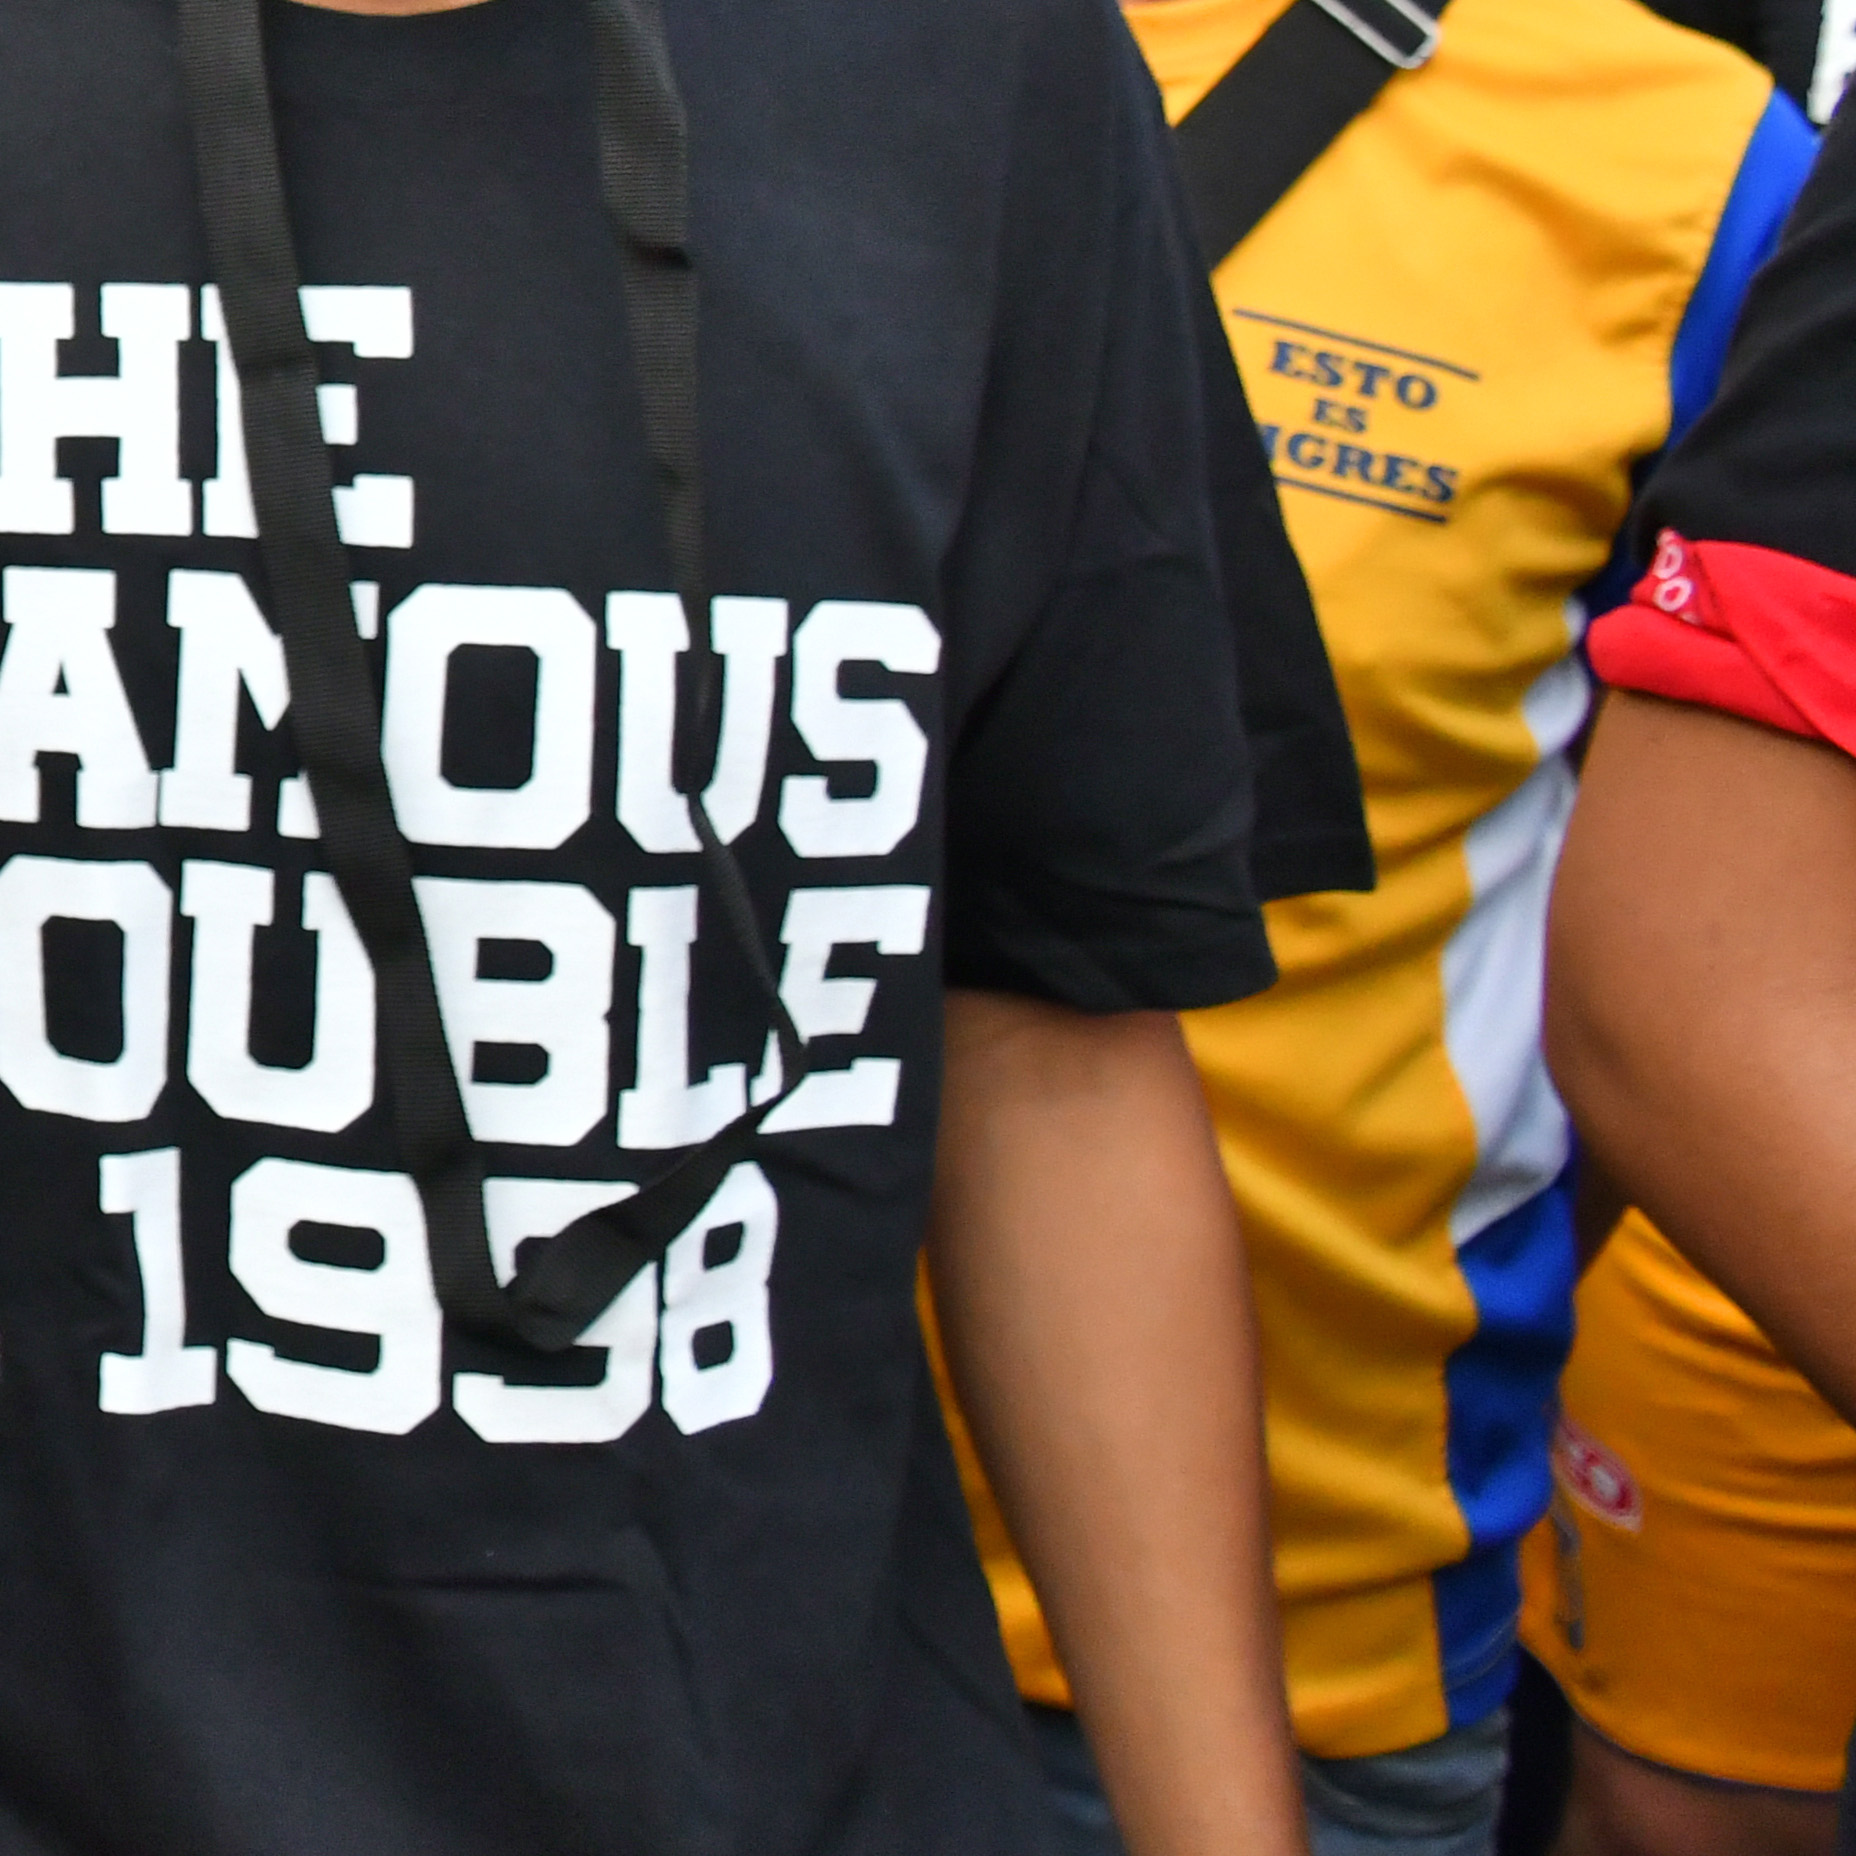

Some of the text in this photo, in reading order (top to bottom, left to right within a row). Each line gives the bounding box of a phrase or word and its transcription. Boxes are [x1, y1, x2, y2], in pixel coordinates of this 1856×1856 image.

[1267, 338, 1438, 412] ESTO
[1312, 397, 1369, 434] ES
[1258, 423, 1458, 505] IGRES
[99, 1147, 778, 1445] 1958
